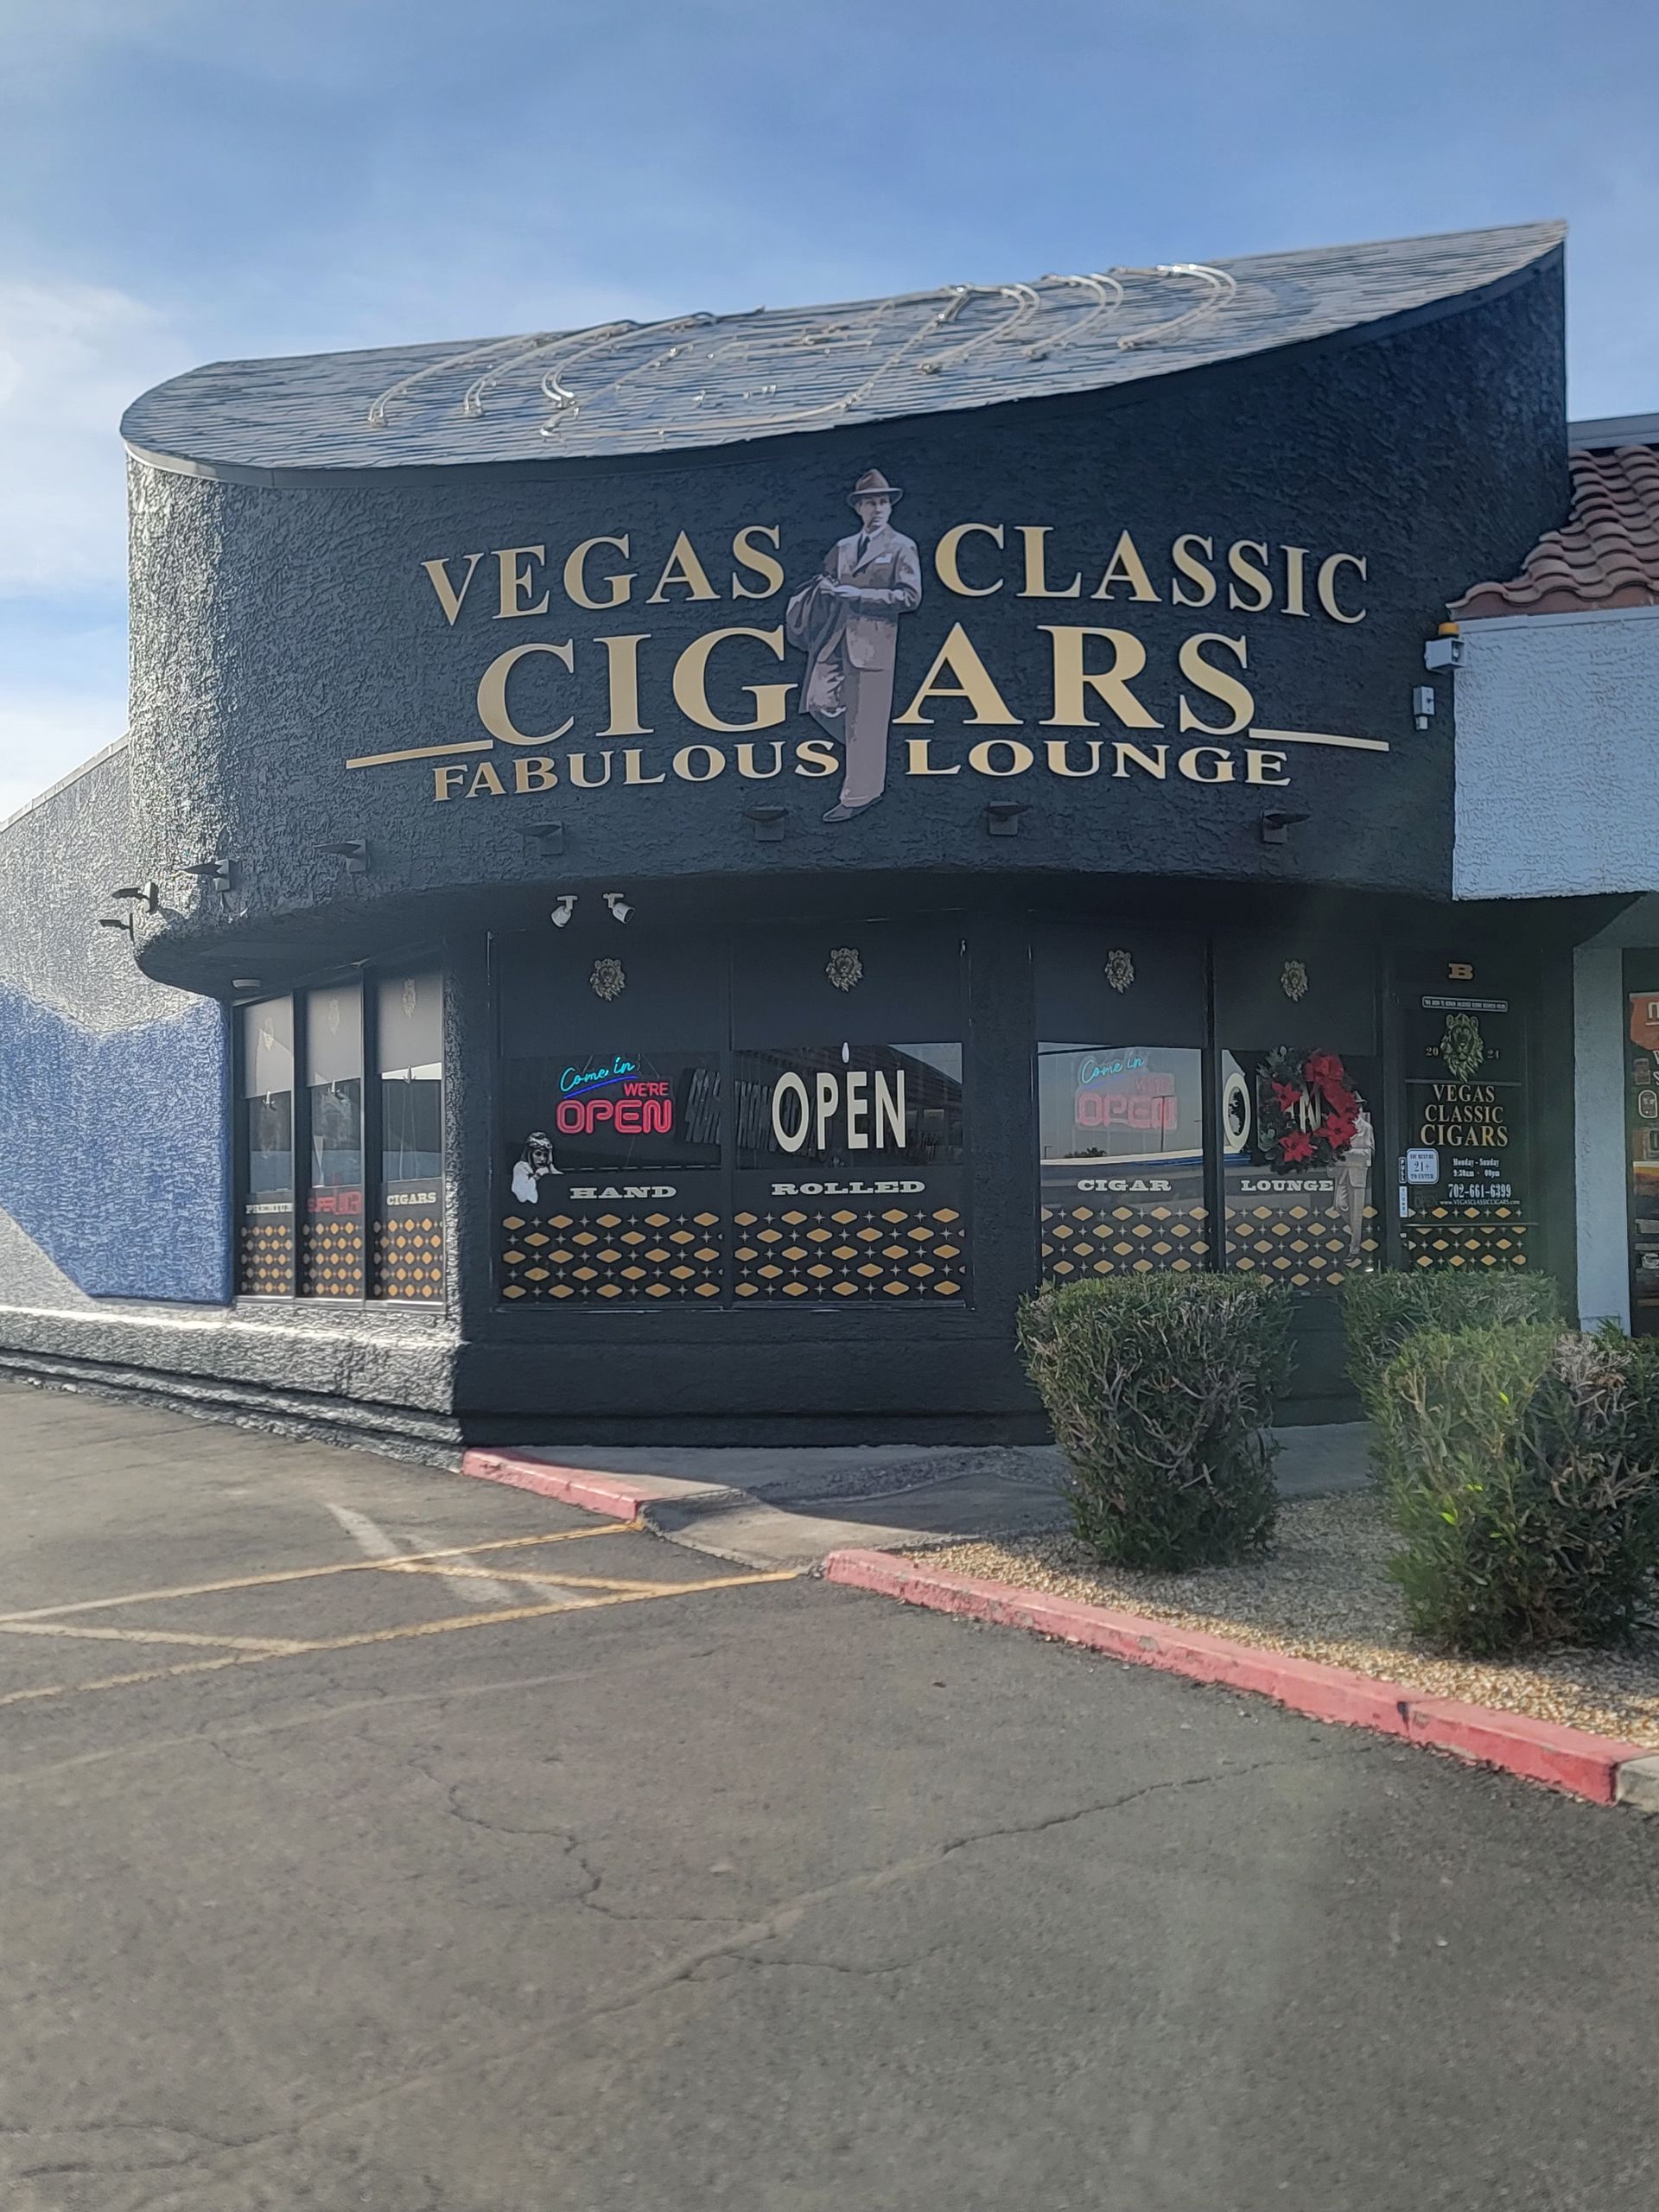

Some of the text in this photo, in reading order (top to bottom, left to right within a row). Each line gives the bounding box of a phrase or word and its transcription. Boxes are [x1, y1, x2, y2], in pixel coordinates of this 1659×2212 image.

[420, 522, 1368, 626] VEGAS CLASSIC
[433, 739, 1292, 802] FABULOUS LOUNGE
[1448, 963, 1474, 980] B
[1426, 1046, 1439, 1057] 20
[560, 1056, 636, 1092] Come in
[1082, 1052, 1145, 1084] Come in
[622, 1081, 670, 1097] WE'RE
[1433, 1084, 1496, 1103] VEGAS
[556, 1099, 672, 1135] OPEN
[772, 1069, 906, 1154] OPEN
[1078, 1091, 1178, 1130] OPEN
[1425, 1104, 1504, 1124] CLASSIC
[1421, 1124, 1509, 1147] CIGARS
[1414, 1160, 1431, 1173] 21+
[1452, 1158, 1475, 1168] Monday
[1479, 1158, 1500, 1168] Sunday
[569, 1185, 677, 1199] HAND
[772, 1180, 926, 1196] ROLLED
[1077, 1179, 1173, 1192] CIGAR
[1240, 1179, 1335, 1192] LOUNGE
[1448, 1183, 1511, 1198] 702-661-6399
[385, 1192, 438, 1206] CIGARS
